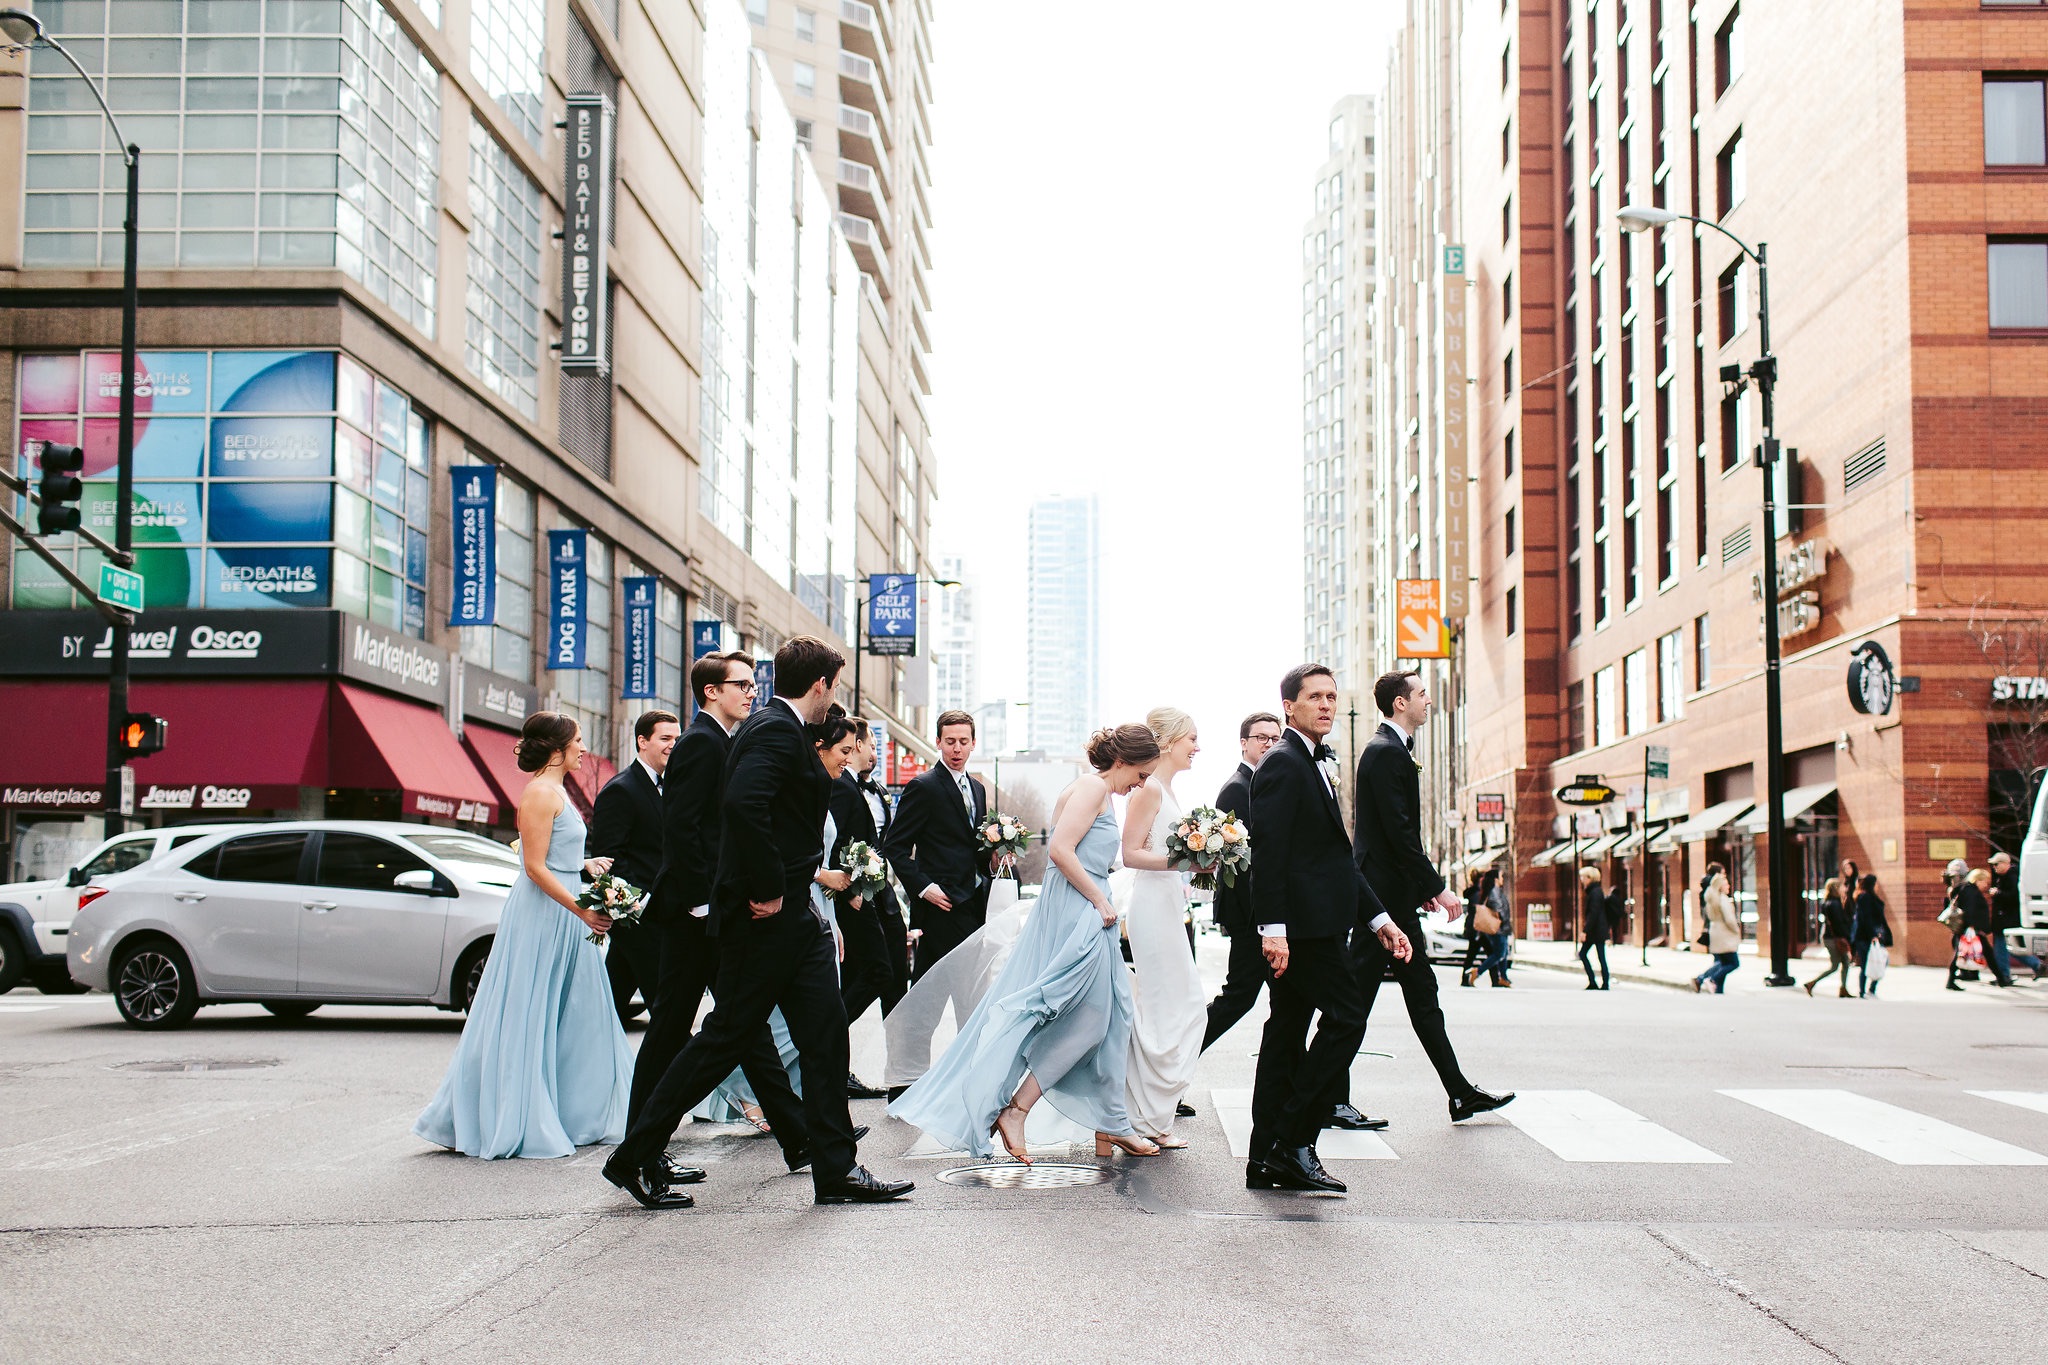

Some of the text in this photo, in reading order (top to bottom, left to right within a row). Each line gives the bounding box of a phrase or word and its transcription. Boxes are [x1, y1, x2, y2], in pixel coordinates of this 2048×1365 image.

[571, 109, 592, 355] BED BATH & BEYOND
[99, 372, 123, 386] BE
[177, 372, 191, 385] &
[99, 386, 192, 398] BEOND
[224, 434, 257, 449] BED
[1445, 287, 1464, 608] EMBASSY SUITES
[224, 449, 320, 462] BEYOND
[92, 500, 117, 515] BE
[173, 500, 188, 514] &
[92, 515, 188, 528] BEOND
[463, 508, 477, 577] 644-7263
[221, 565, 317, 581] BED BATH &
[221, 580, 317, 593] BEYOND
[561, 567, 576, 618] PARK
[1401, 581, 1432, 595] Self
[462, 580, 478, 620] (312)
[876, 595, 910, 607] SELF
[1401, 595, 1438, 610] Park
[874, 607, 912, 620] PARK
[62, 625, 262, 658] BY Jwel Osco
[559, 622, 576, 663] DOG
[354, 625, 440, 687] Marketplace
[4, 787, 101, 807] Marketplace
[142, 785, 197, 804] Jewel
[202, 785, 251, 804] Osco
